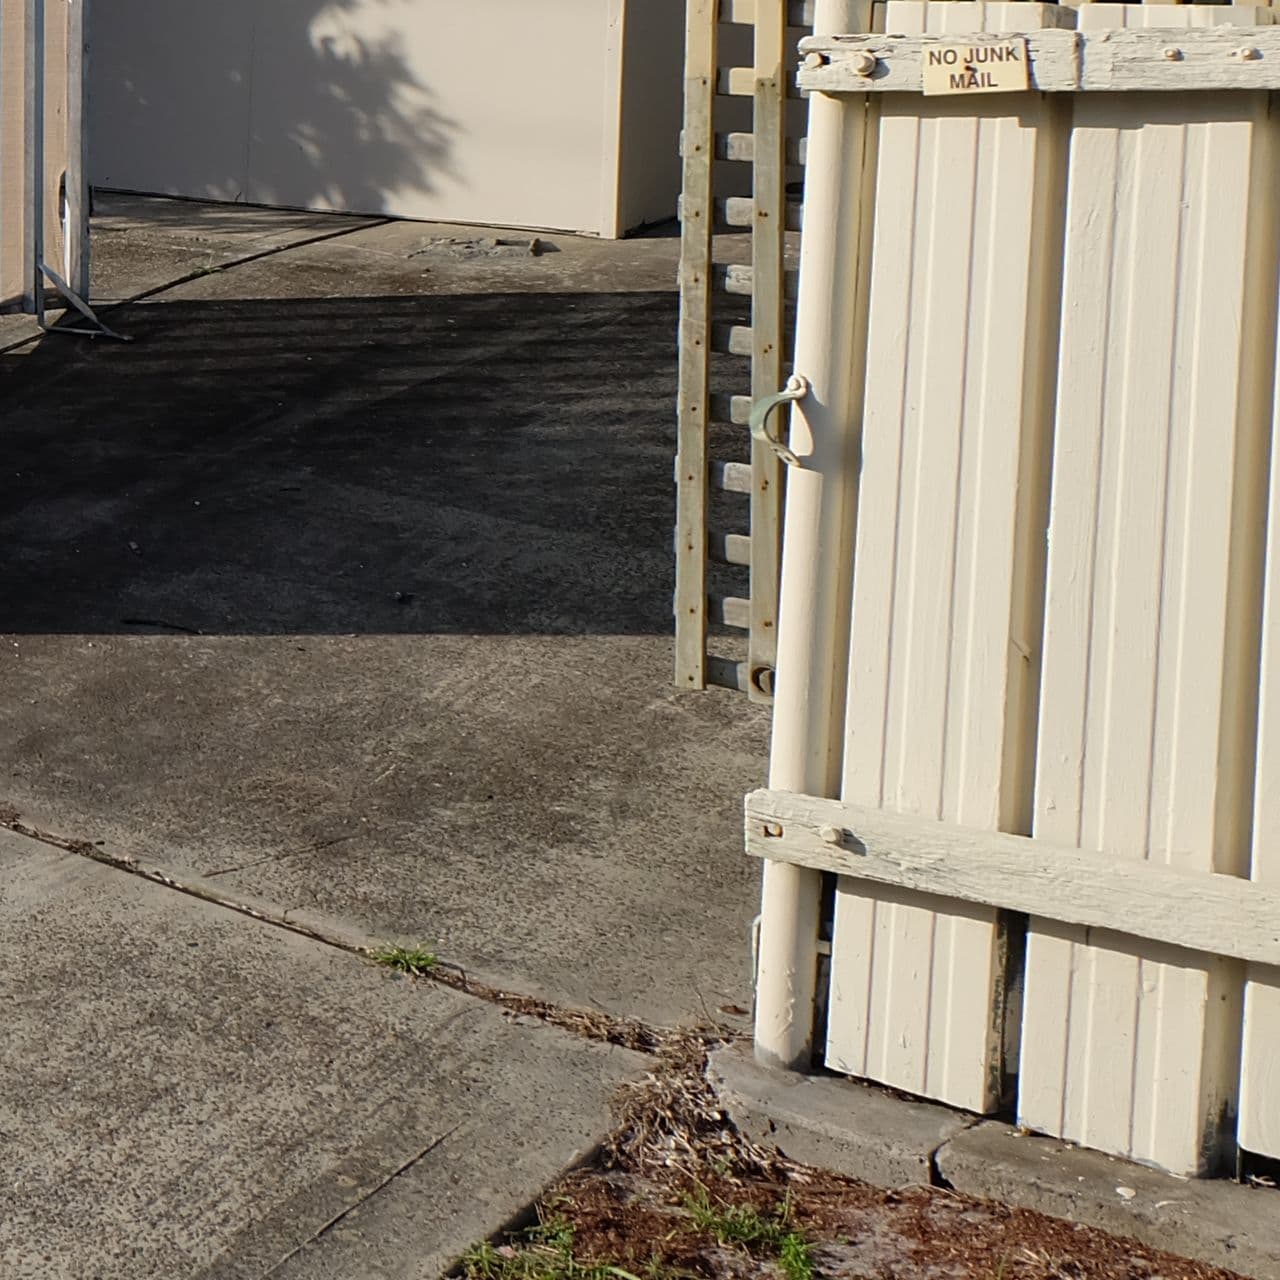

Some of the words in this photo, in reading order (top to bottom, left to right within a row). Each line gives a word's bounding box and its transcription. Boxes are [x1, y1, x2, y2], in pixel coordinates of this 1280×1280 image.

[928, 49, 958, 66] NO
[963, 46, 1020, 64] JUNK
[949, 71, 999, 89] MAIL
